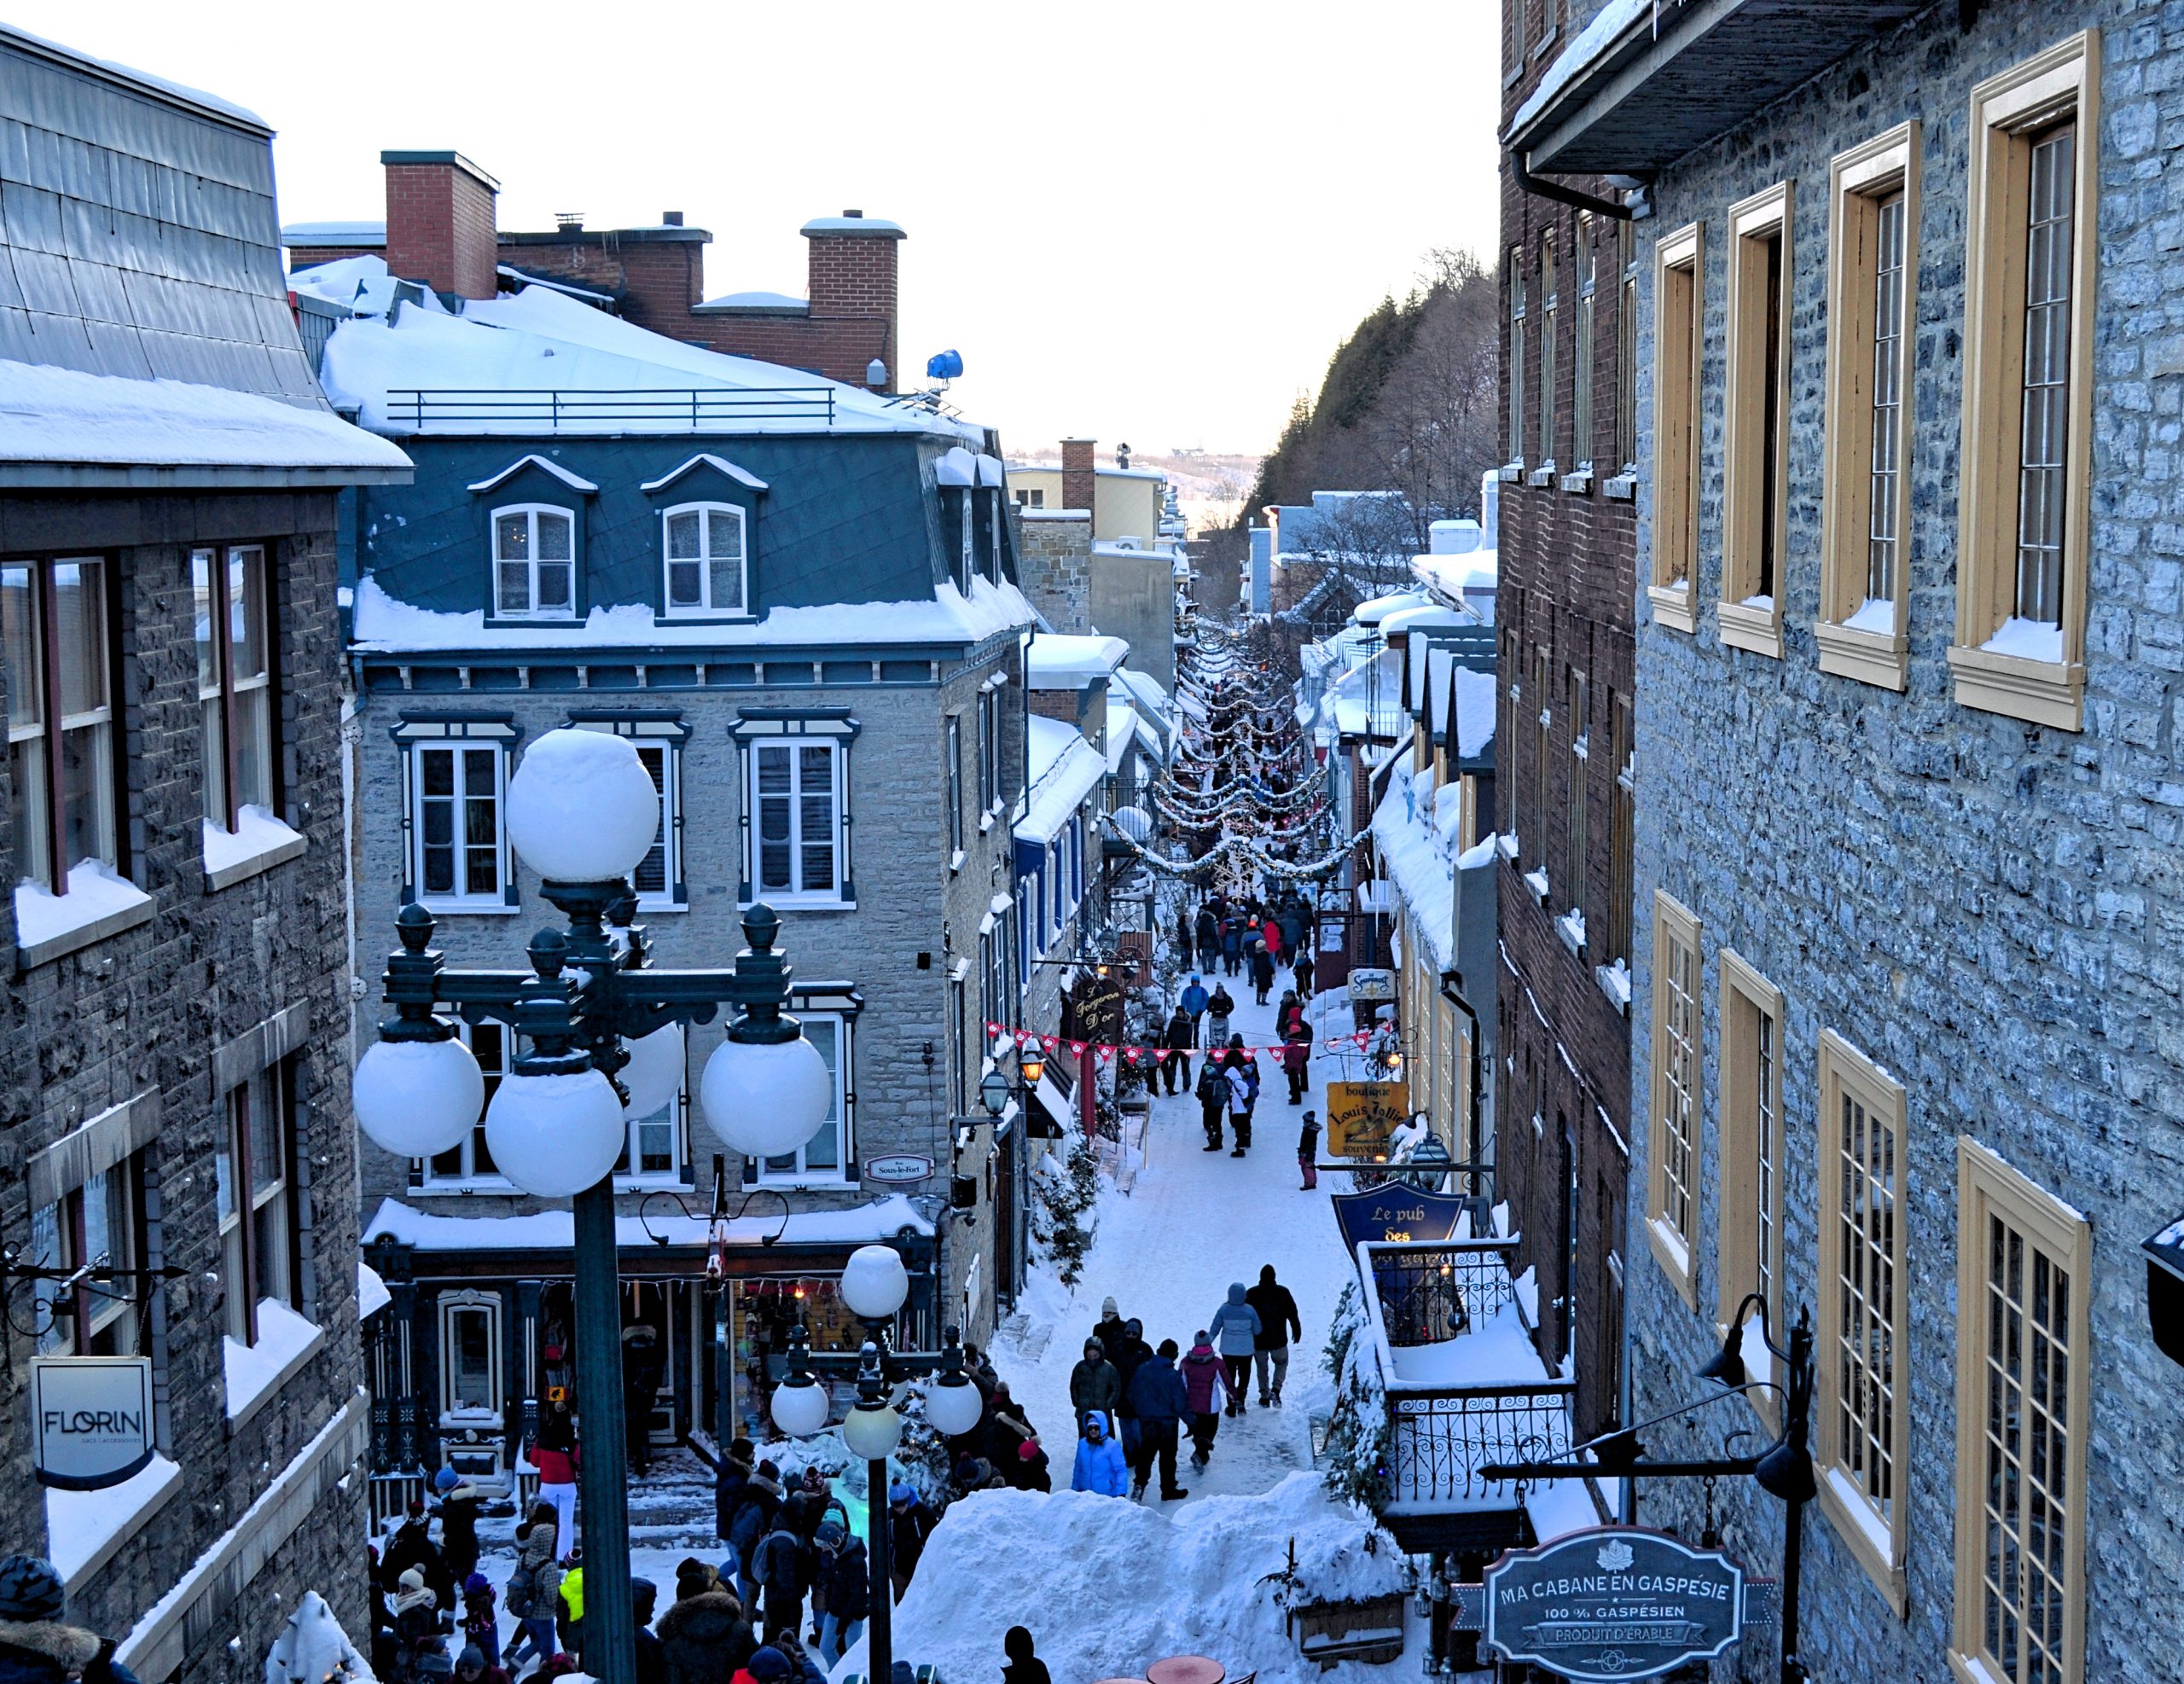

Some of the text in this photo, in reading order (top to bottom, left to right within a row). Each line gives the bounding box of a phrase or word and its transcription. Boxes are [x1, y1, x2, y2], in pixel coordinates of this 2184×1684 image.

[1076, 992, 1120, 1018] Forgeron
[1345, 1084, 1391, 1099] boutique
[1329, 1100, 1405, 1125] Louis Jollie
[878, 1165, 920, 1174] Sous-le-Fort
[1371, 1204, 1426, 1224] Le pub
[1385, 1226, 1411, 1243] des
[44, 1410, 141, 1434] FLORIN
[1501, 1574, 1730, 1606] MA CABANE EN GASPÉSIE
[1544, 1604, 1686, 1619] 100 % GASPÉSIEN
[1555, 1625, 1674, 1642] PRODUIT D'ÉRABLE
